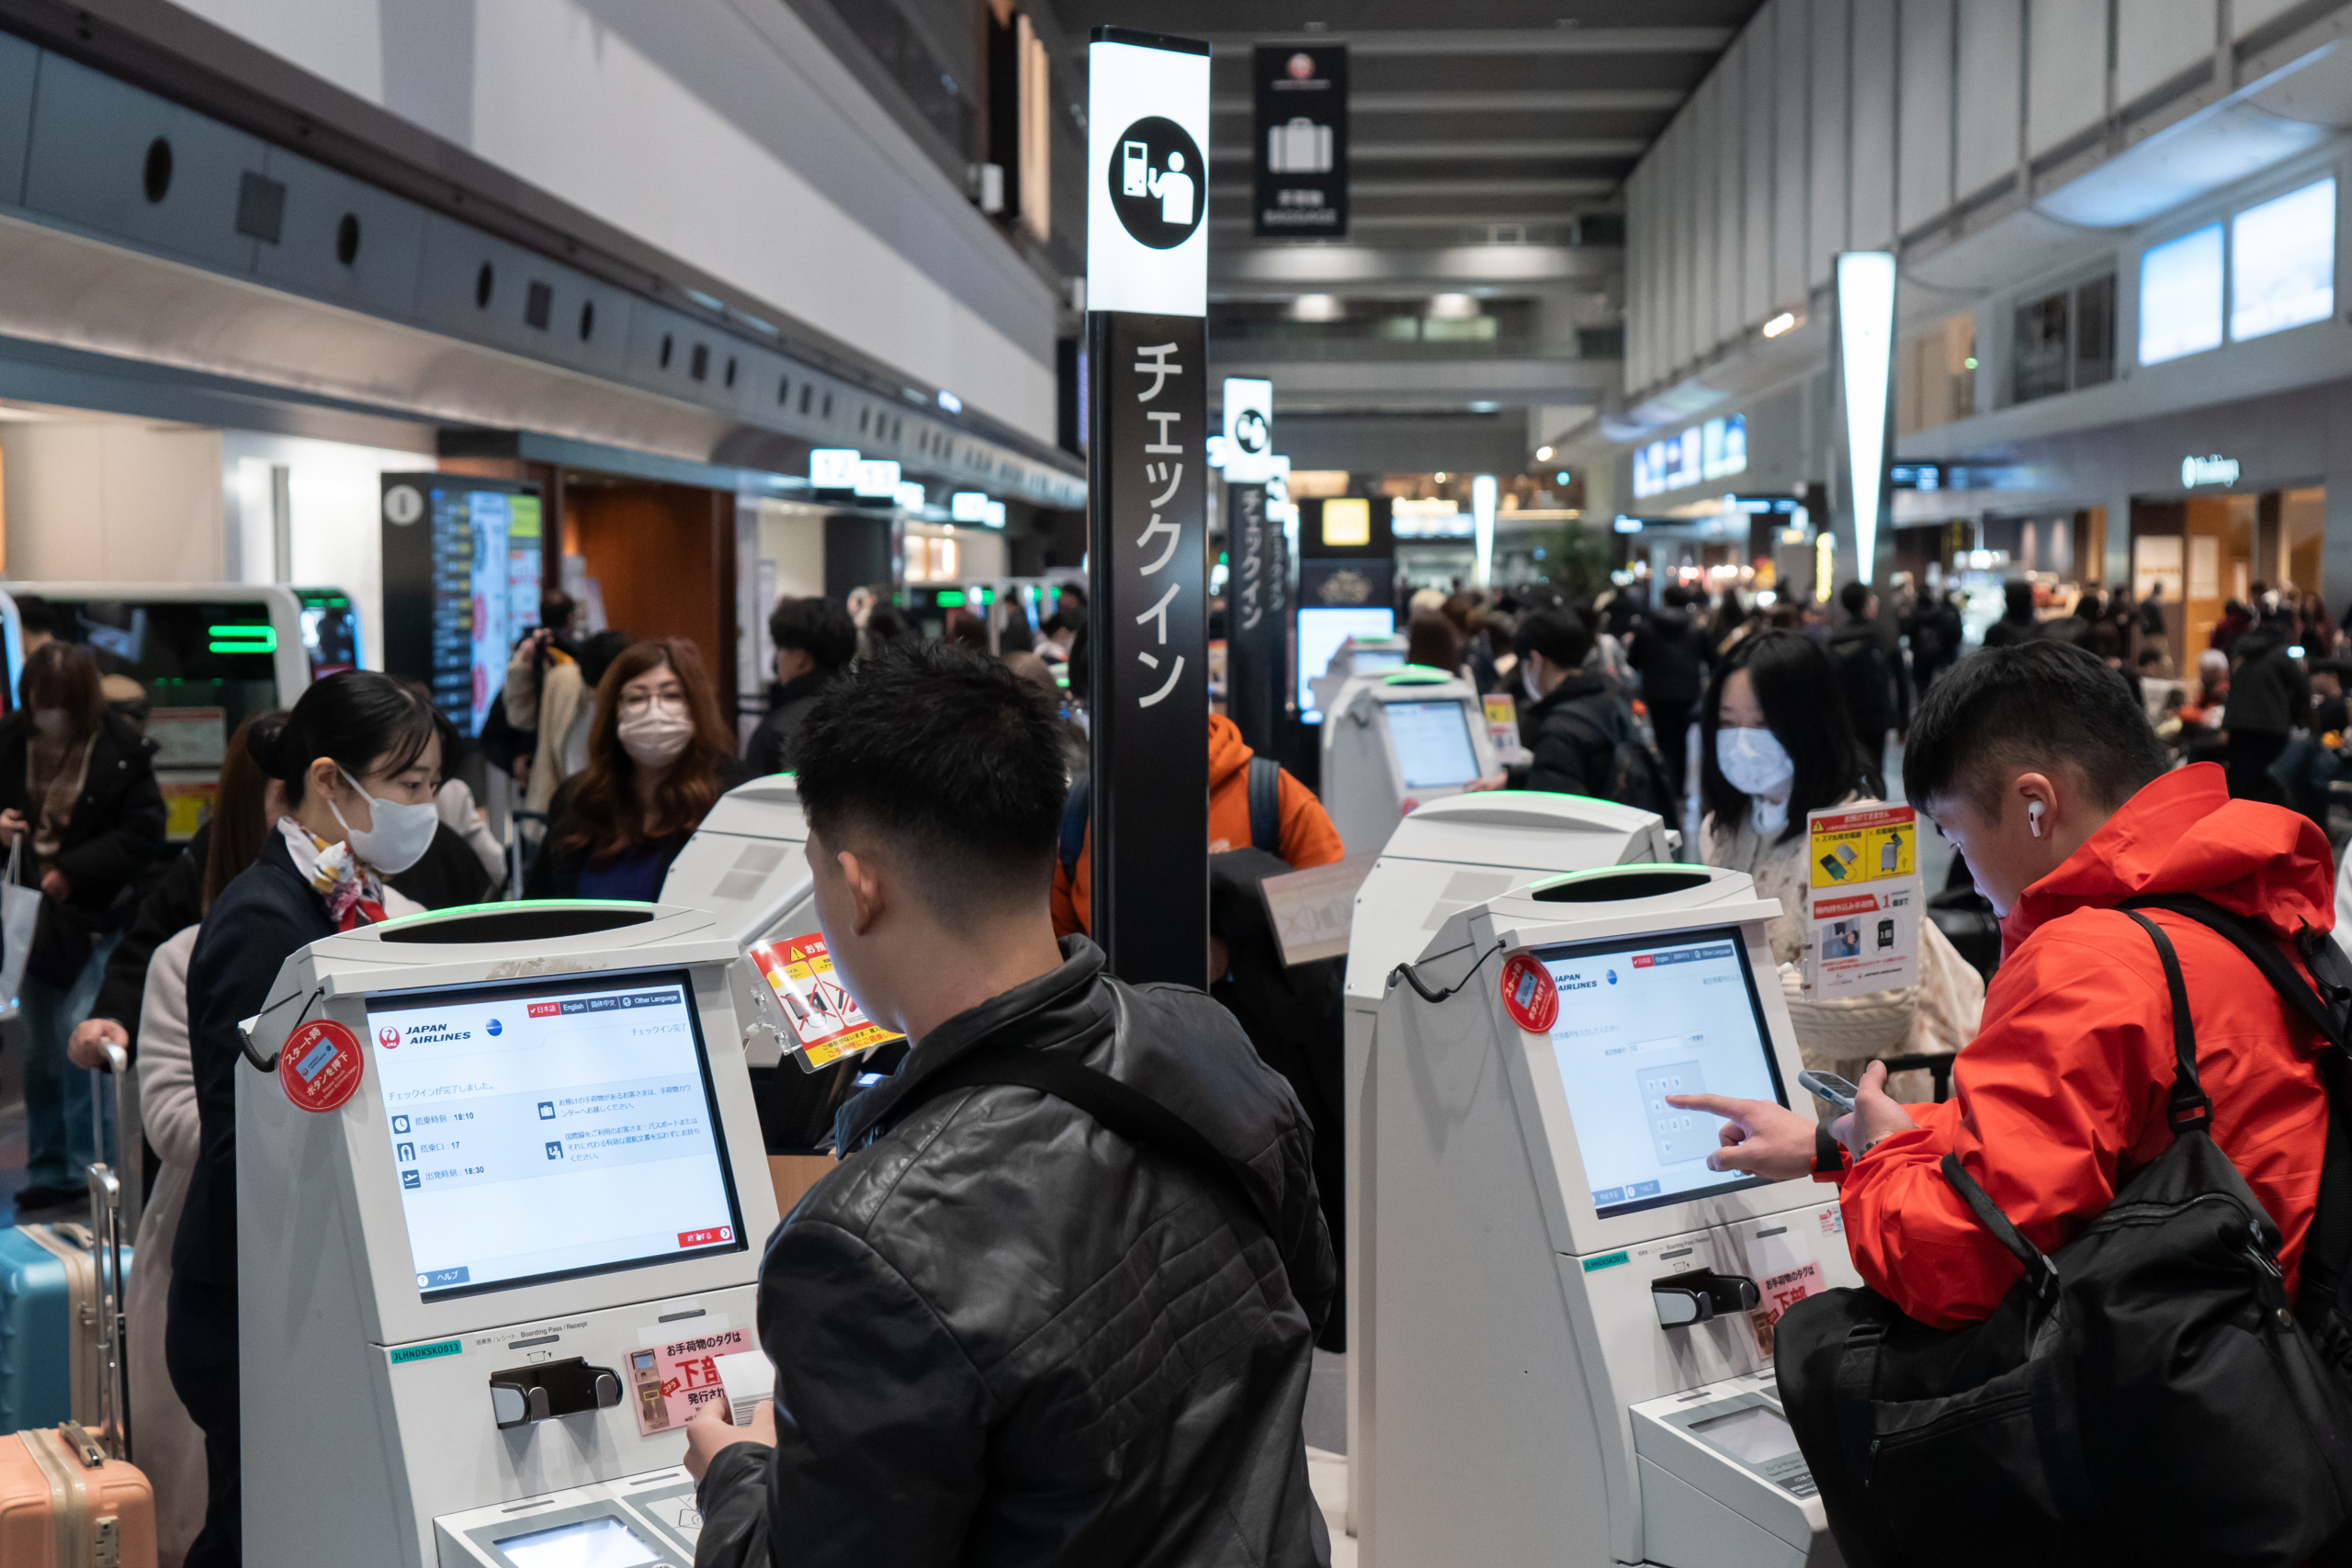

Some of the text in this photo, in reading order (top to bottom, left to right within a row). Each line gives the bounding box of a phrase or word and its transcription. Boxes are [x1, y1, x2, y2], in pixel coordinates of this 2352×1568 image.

[1134, 342, 1185, 708] チェックイン
[1241, 489, 1262, 630] チェックイン
[1558, 980, 1598, 992] AIRLINES
[537, 1006, 557, 1014] 日本語
[563, 1003, 584, 1012] English
[650, 993, 678, 1004] Language
[405, 1023, 447, 1035] JAPAN
[630, 1022, 687, 1037] チェックイン完了
[284, 1026, 322, 1066] スタート時
[410, 1031, 471, 1045] AIRLINES
[306, 1050, 348, 1097] ボタンを押下
[387, 1082, 494, 1101] チェックインが完了しました。
[454, 1111, 474, 1121] 18:10
[451, 1141, 460, 1149] 17
[464, 1166, 485, 1176] 18:30
[436, 1269, 459, 1281] ヘルプ
[1766, 1266, 1815, 1291] お手荷物のタグは
[520, 1327, 548, 1339] Boarding
[548, 1325, 563, 1334] Pass
[566, 1320, 588, 1331] Receipt
[666, 1331, 741, 1357] お手荷物のタグは
[662, 1381, 677, 1395] コチラ
